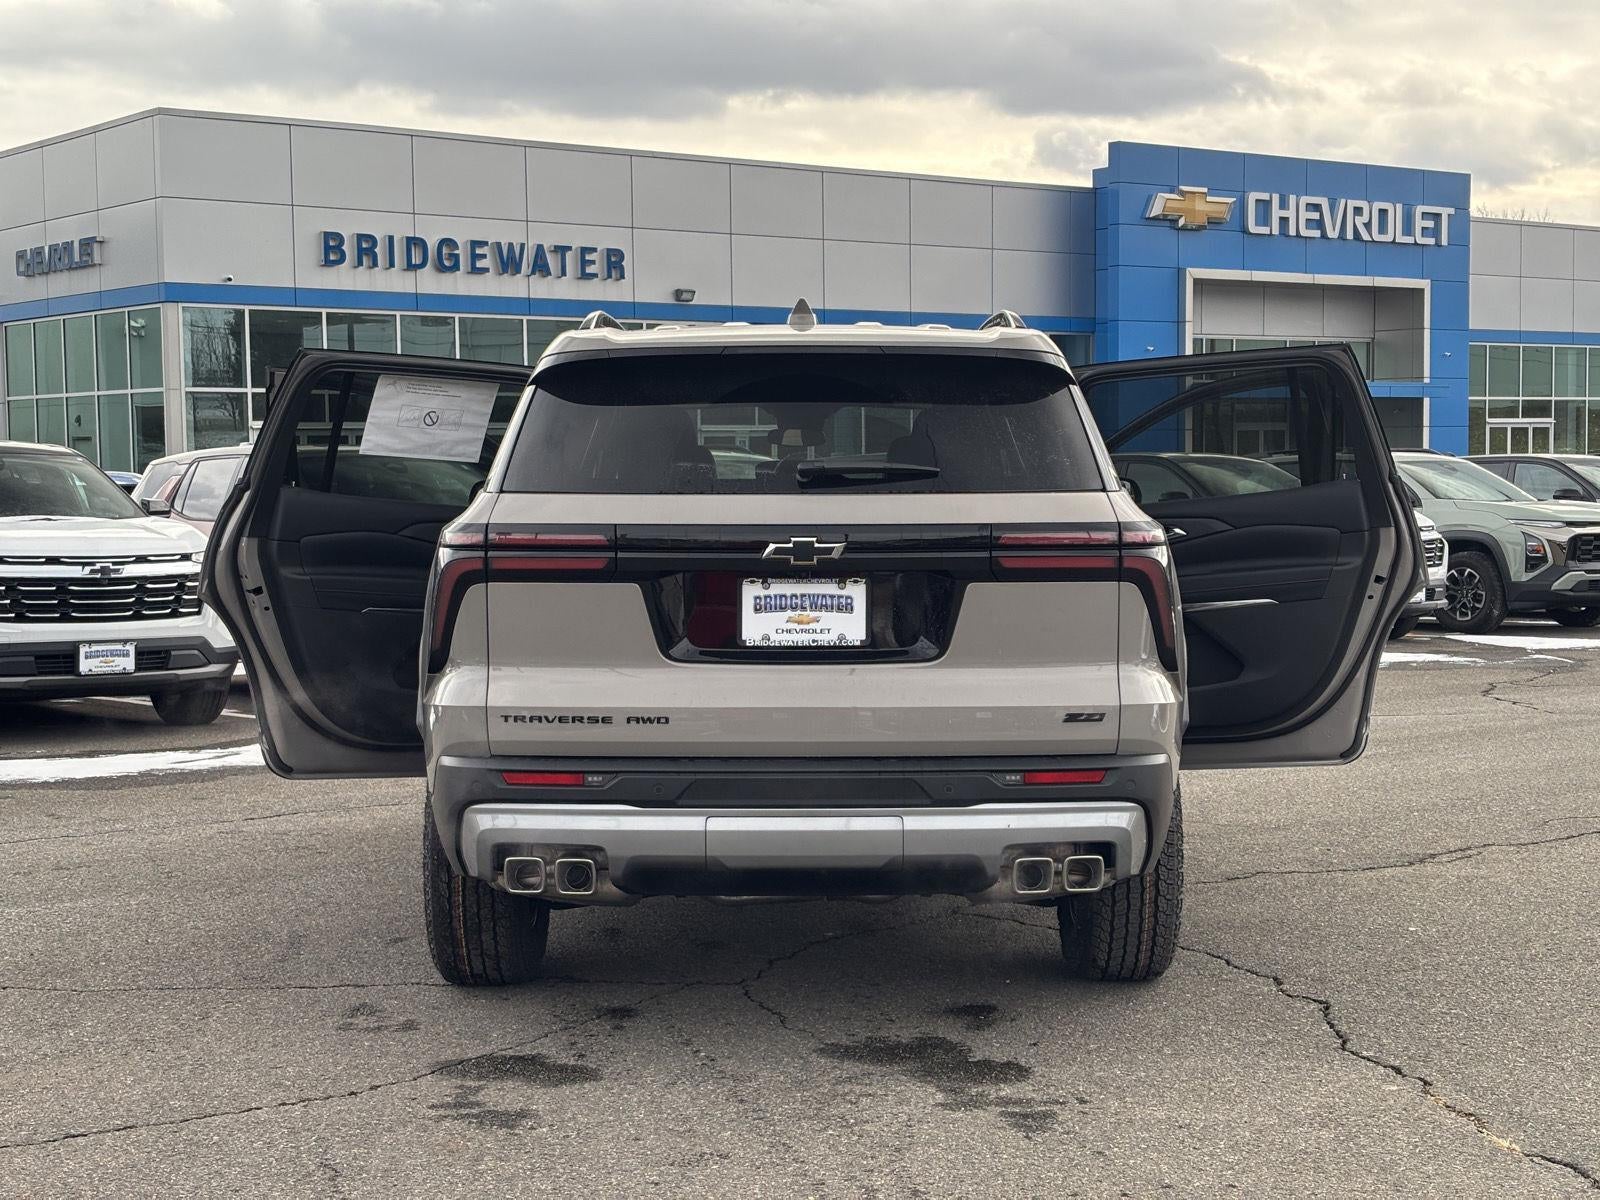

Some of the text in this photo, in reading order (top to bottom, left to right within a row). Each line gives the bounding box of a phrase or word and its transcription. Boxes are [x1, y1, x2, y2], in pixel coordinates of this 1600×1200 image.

[1247, 191, 1455, 247] CHEVROLET
[16, 236, 104, 277] CHEVROLET
[320, 230, 626, 280] BRIDGEWATER
[753, 593, 854, 614] BRIDGEWATER
[775, 627, 832, 635] CHEVROLET
[500, 714, 670, 725] TRAVERSE AWD
